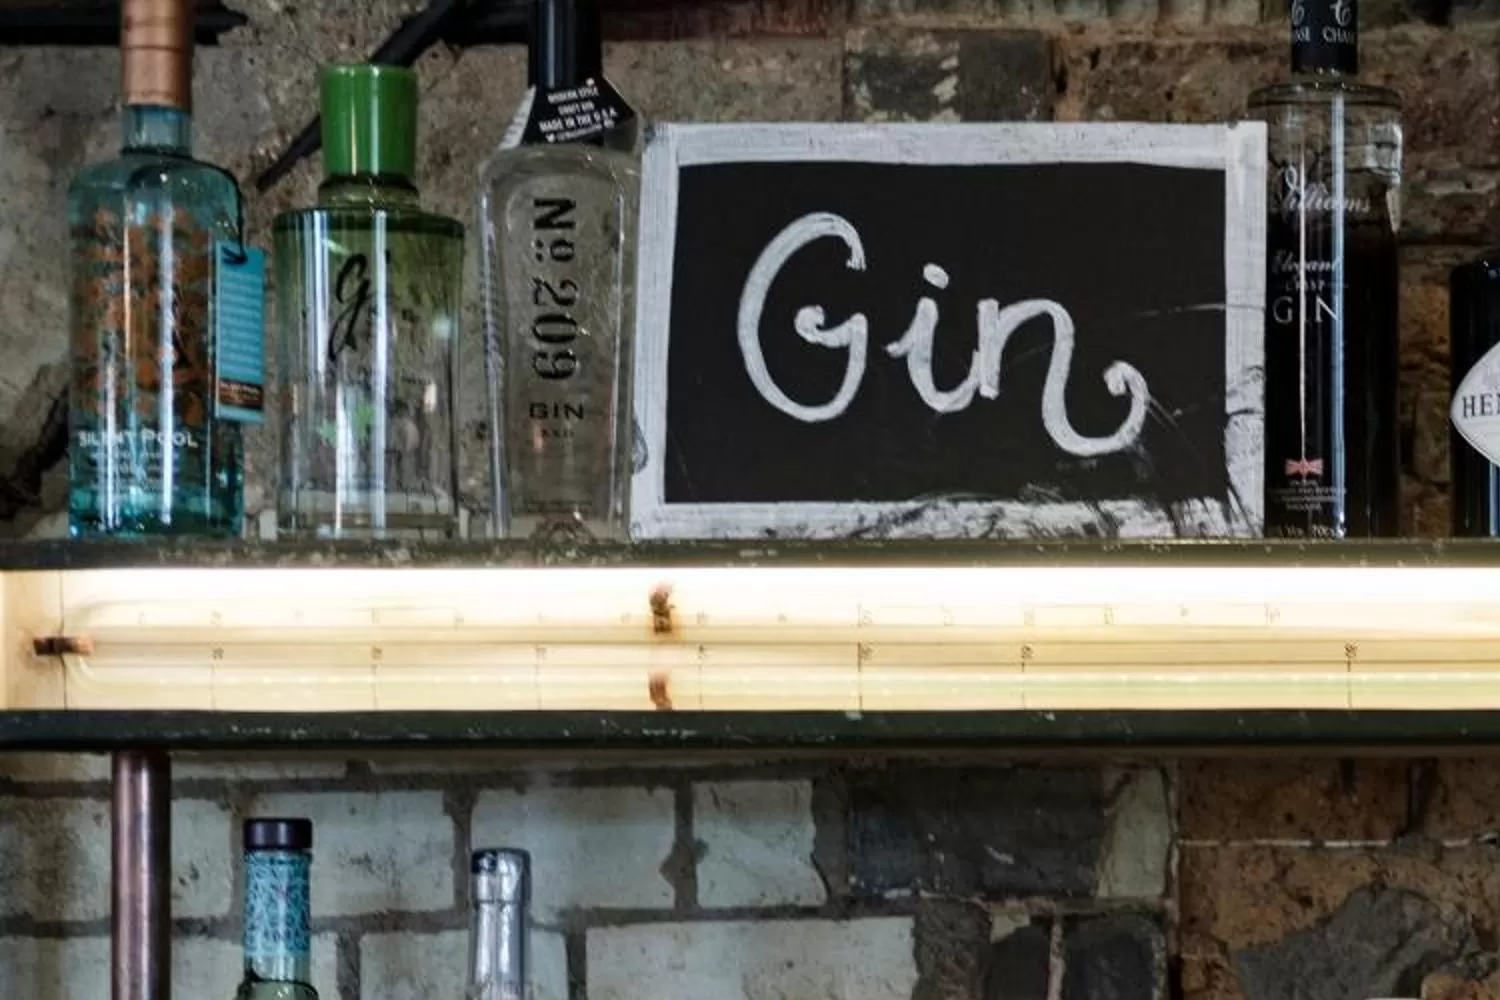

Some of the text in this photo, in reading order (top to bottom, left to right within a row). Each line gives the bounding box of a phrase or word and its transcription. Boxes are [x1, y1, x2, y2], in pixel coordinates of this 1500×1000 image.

[531, 276, 579, 381] 209
[736, 211, 1150, 457] Gin
[529, 402, 585, 420] GIN
